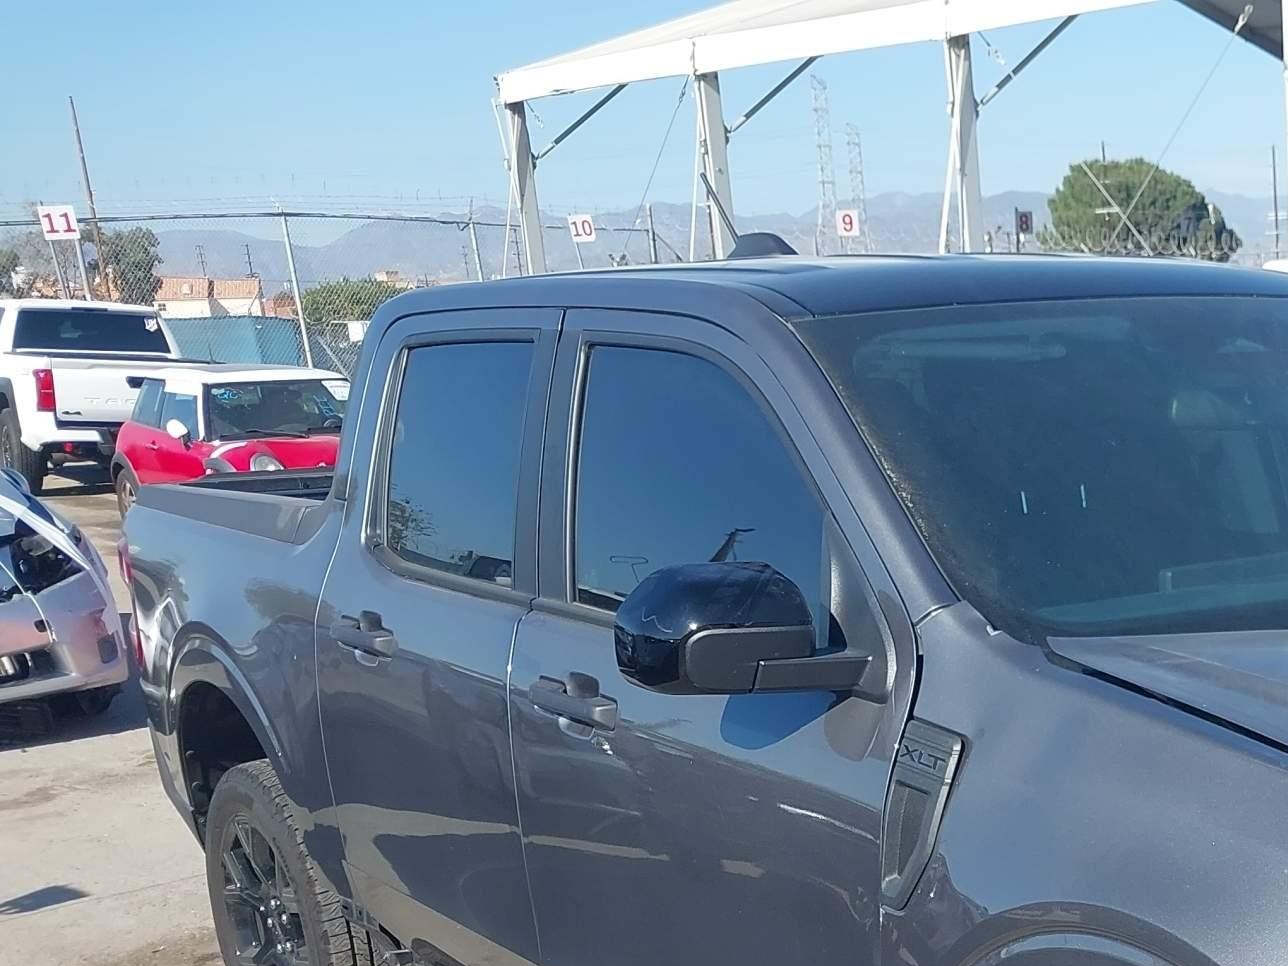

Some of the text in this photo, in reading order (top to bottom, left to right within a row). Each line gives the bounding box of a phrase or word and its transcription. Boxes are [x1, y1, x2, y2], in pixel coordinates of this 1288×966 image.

[41, 212, 77, 234] 11
[570, 219, 593, 237] 10
[842, 213, 853, 232] 9
[1019, 213, 1030, 232] 8
[900, 744, 946, 770] XLT
